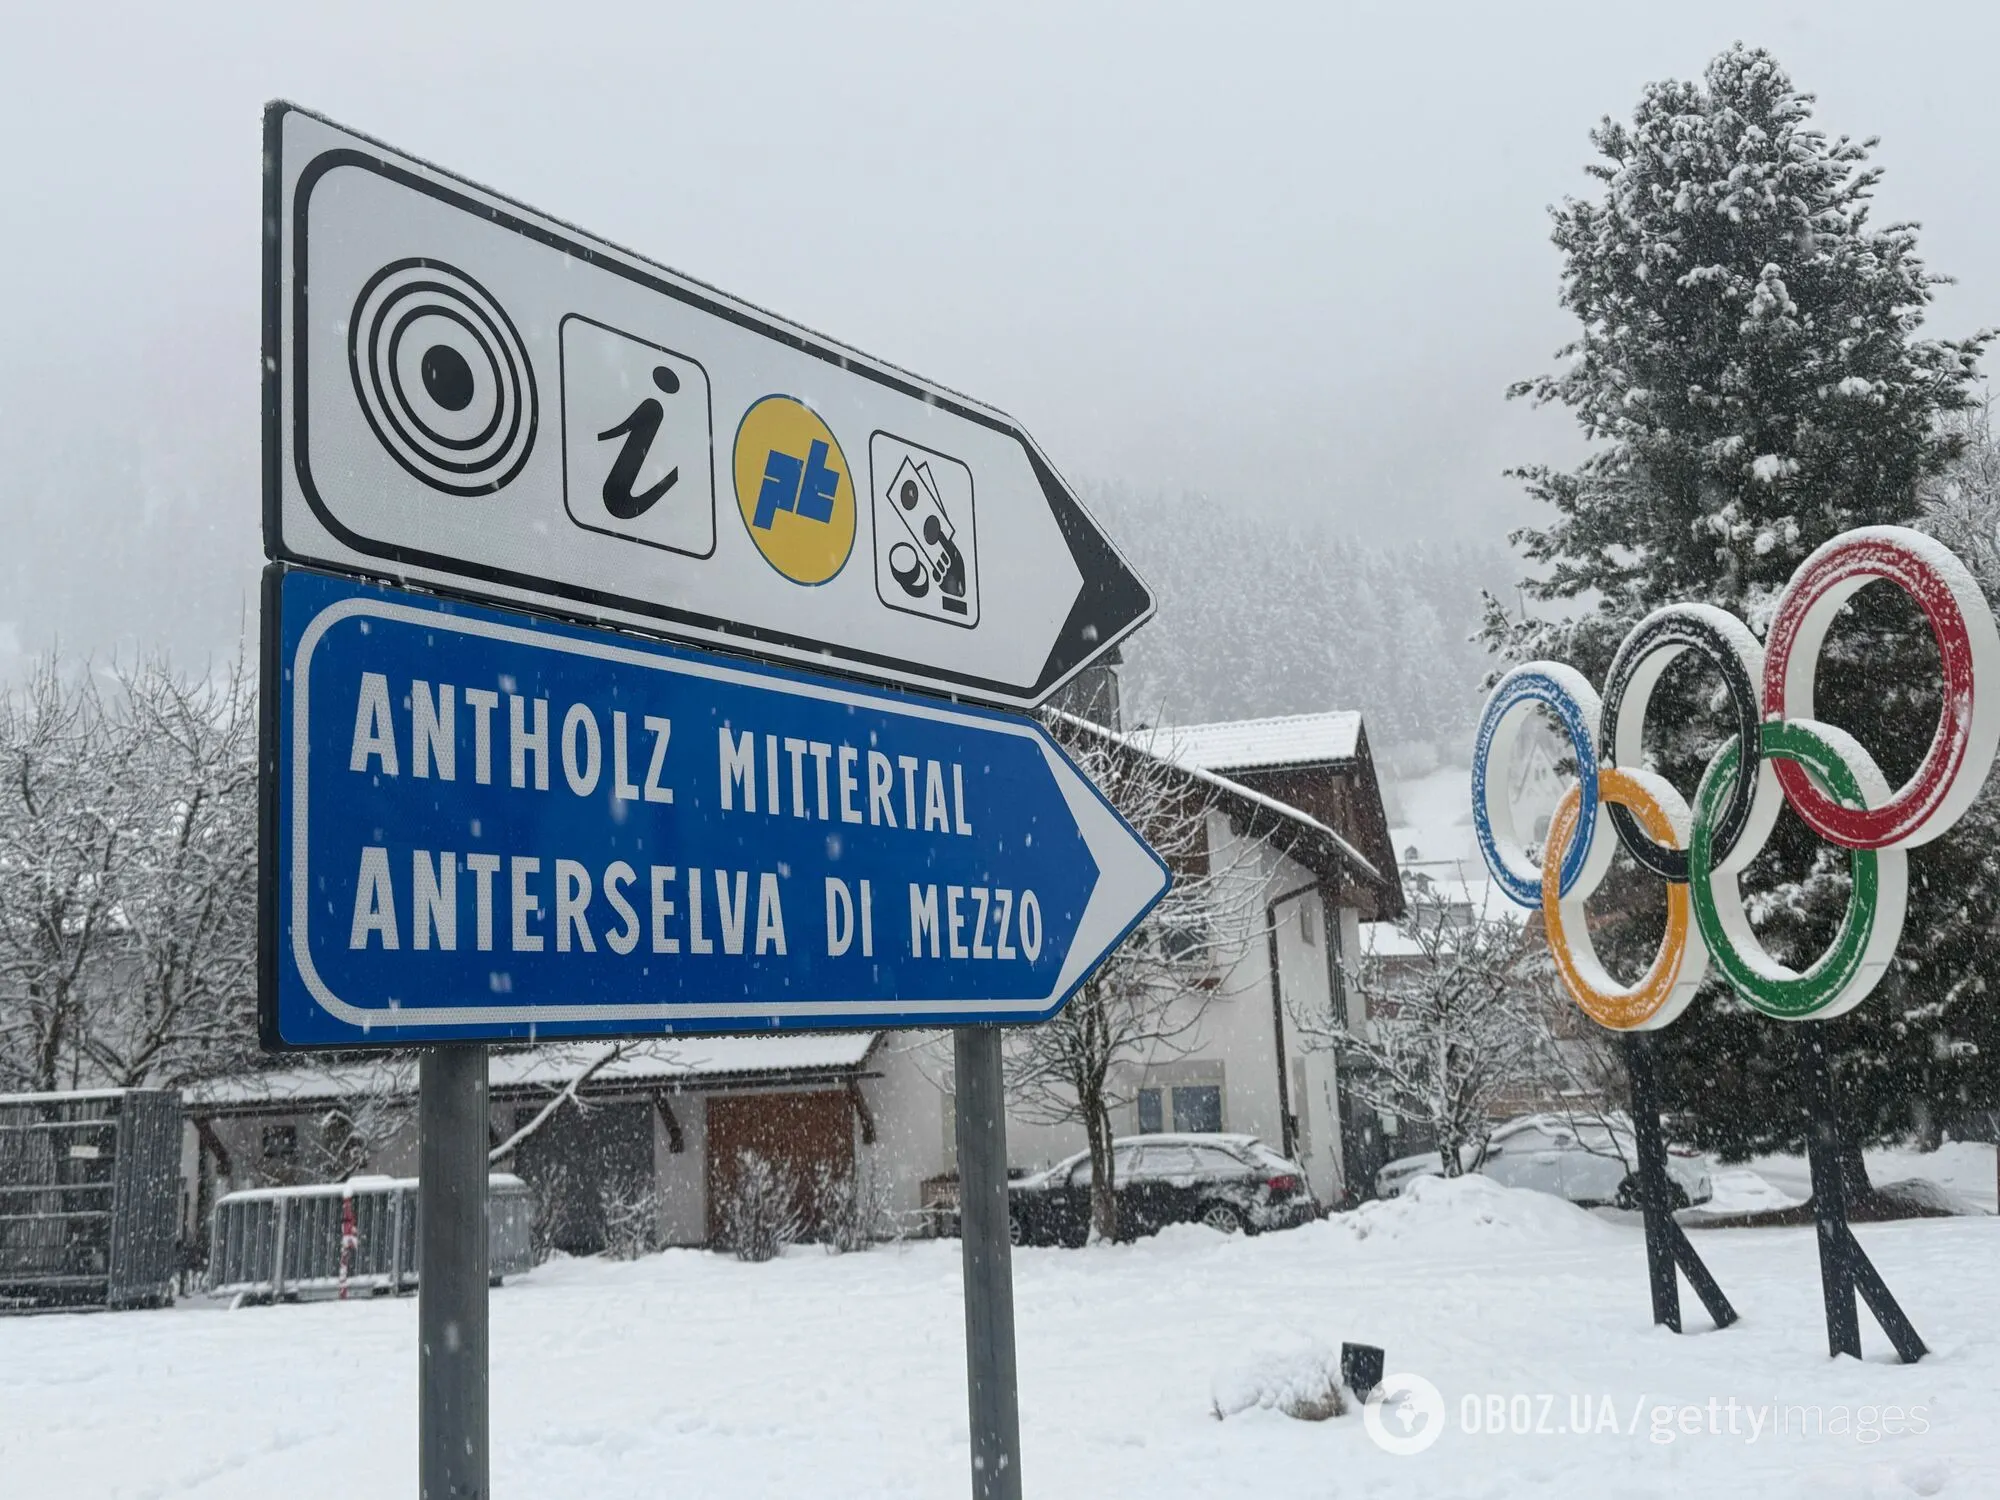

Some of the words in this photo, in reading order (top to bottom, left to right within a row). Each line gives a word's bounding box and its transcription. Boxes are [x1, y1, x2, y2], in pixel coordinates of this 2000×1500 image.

[350, 672, 674, 804] ANTHOLZ
[719, 727, 973, 836] MITTERTAL
[350, 846, 787, 955] ANTERSELVA
[825, 876, 872, 958] DI
[909, 883, 1043, 962] MEZZO
